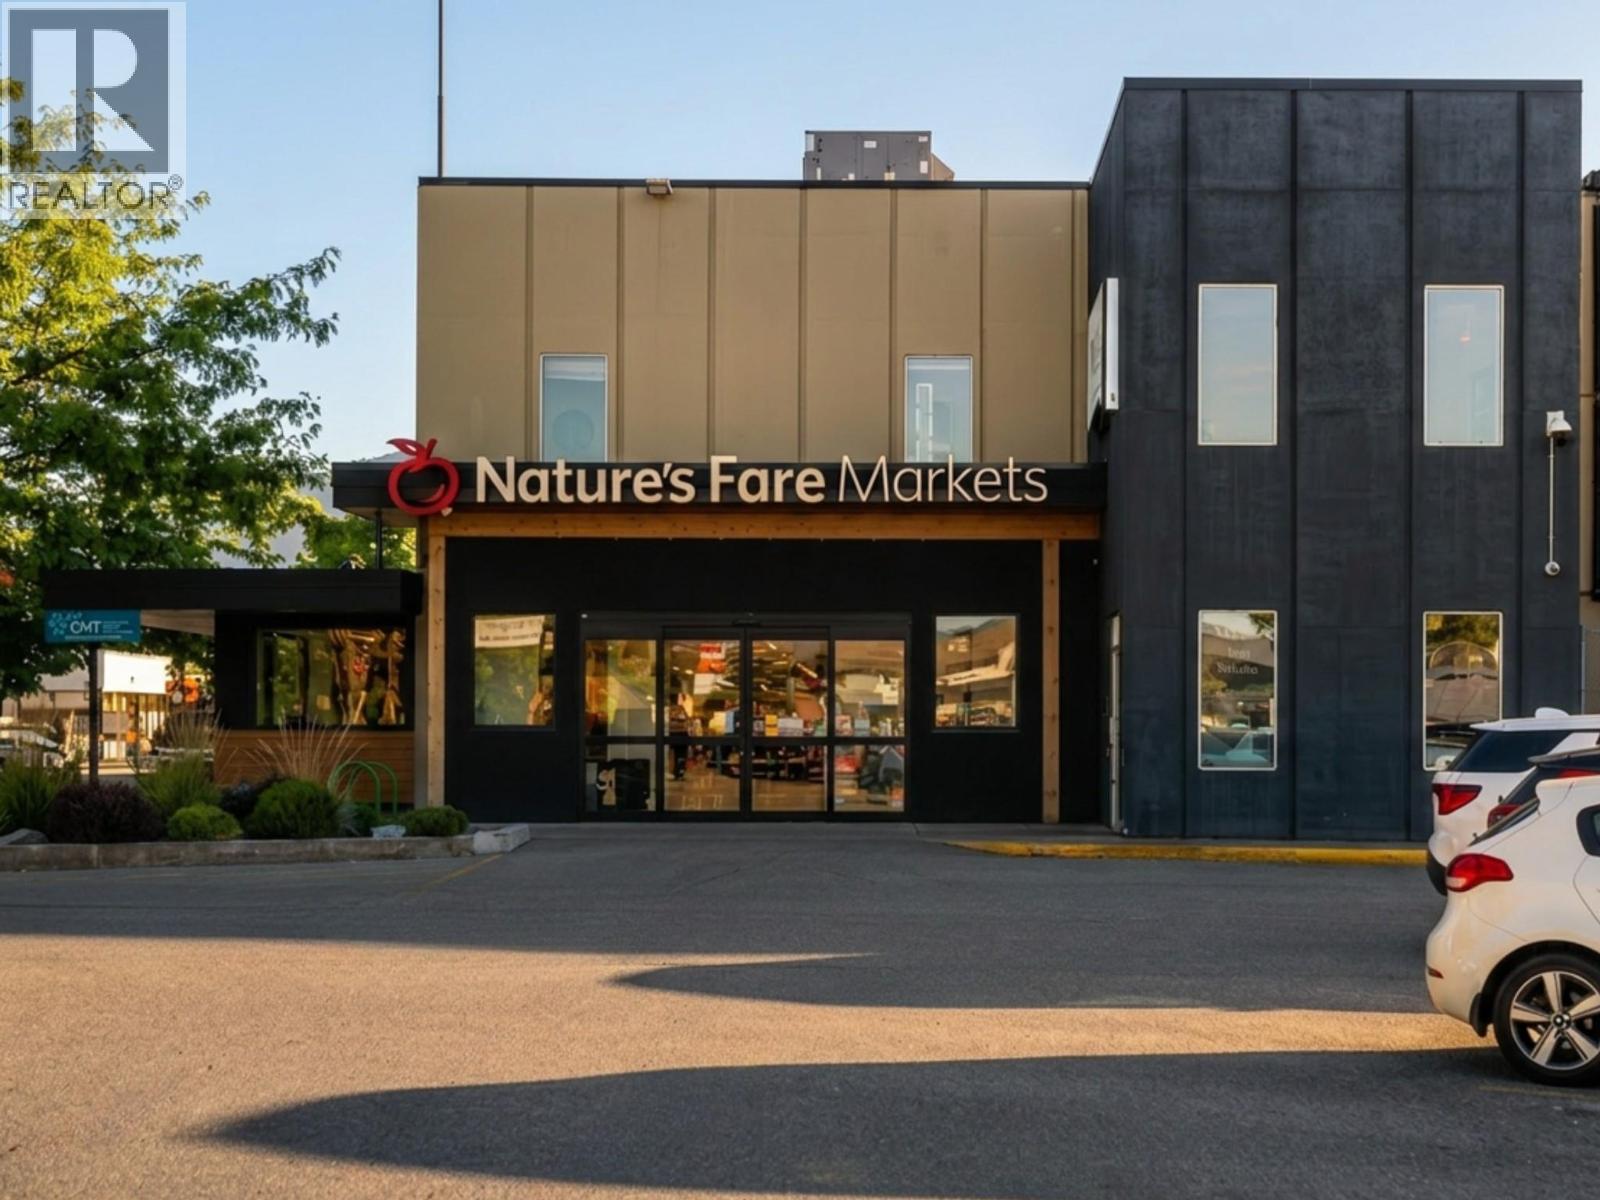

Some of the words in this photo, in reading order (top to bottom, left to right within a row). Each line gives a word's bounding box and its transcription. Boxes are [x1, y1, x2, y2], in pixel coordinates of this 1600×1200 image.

[476, 455, 696, 503] Nature's
[710, 455, 826, 503] Fare
[838, 454, 1048, 503] Markets
